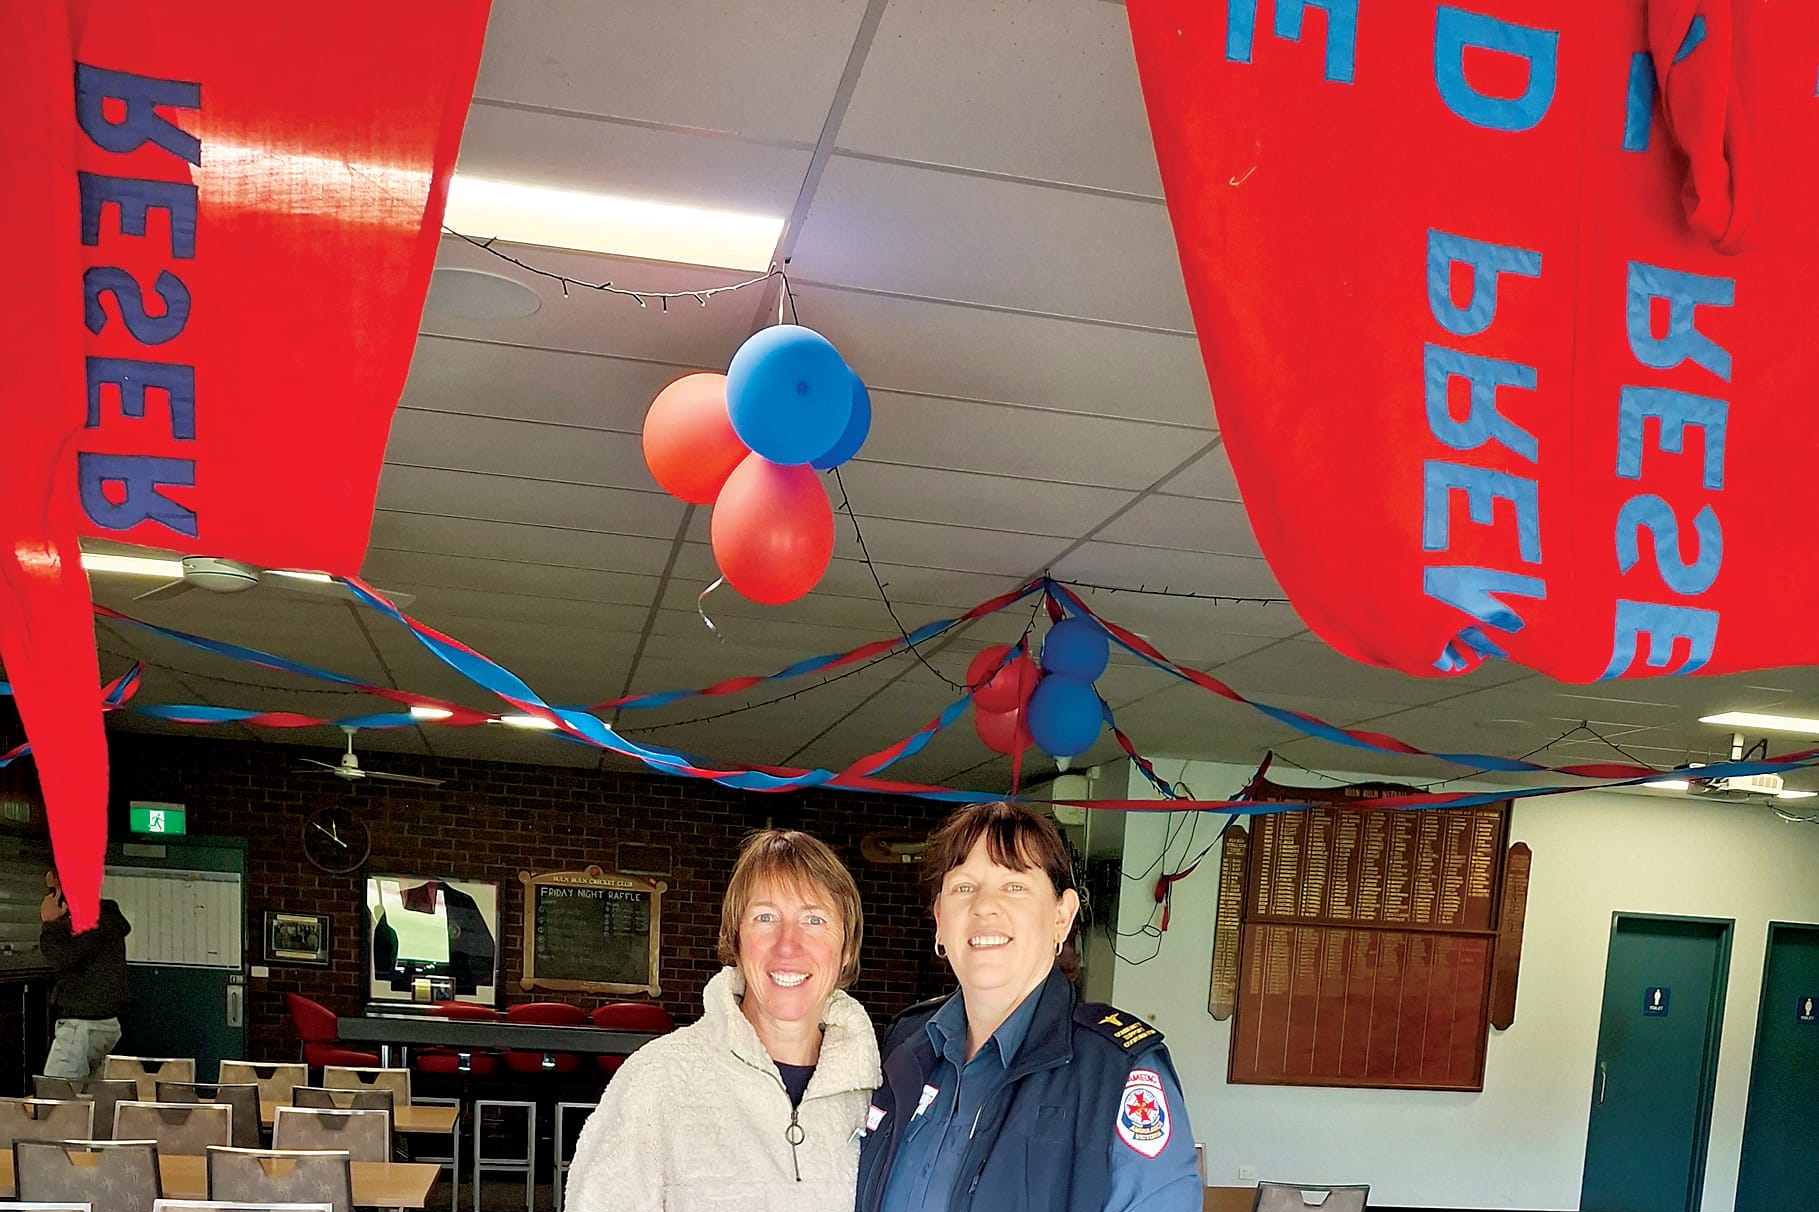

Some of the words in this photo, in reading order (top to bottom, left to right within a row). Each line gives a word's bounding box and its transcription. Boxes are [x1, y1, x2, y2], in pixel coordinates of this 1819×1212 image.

[540, 887, 574, 897] FRIDAY
[577, 889, 604, 899] NIGHT
[608, 892, 641, 902] RAFFLE
[1127, 1073, 1158, 1084] AMEDIC
